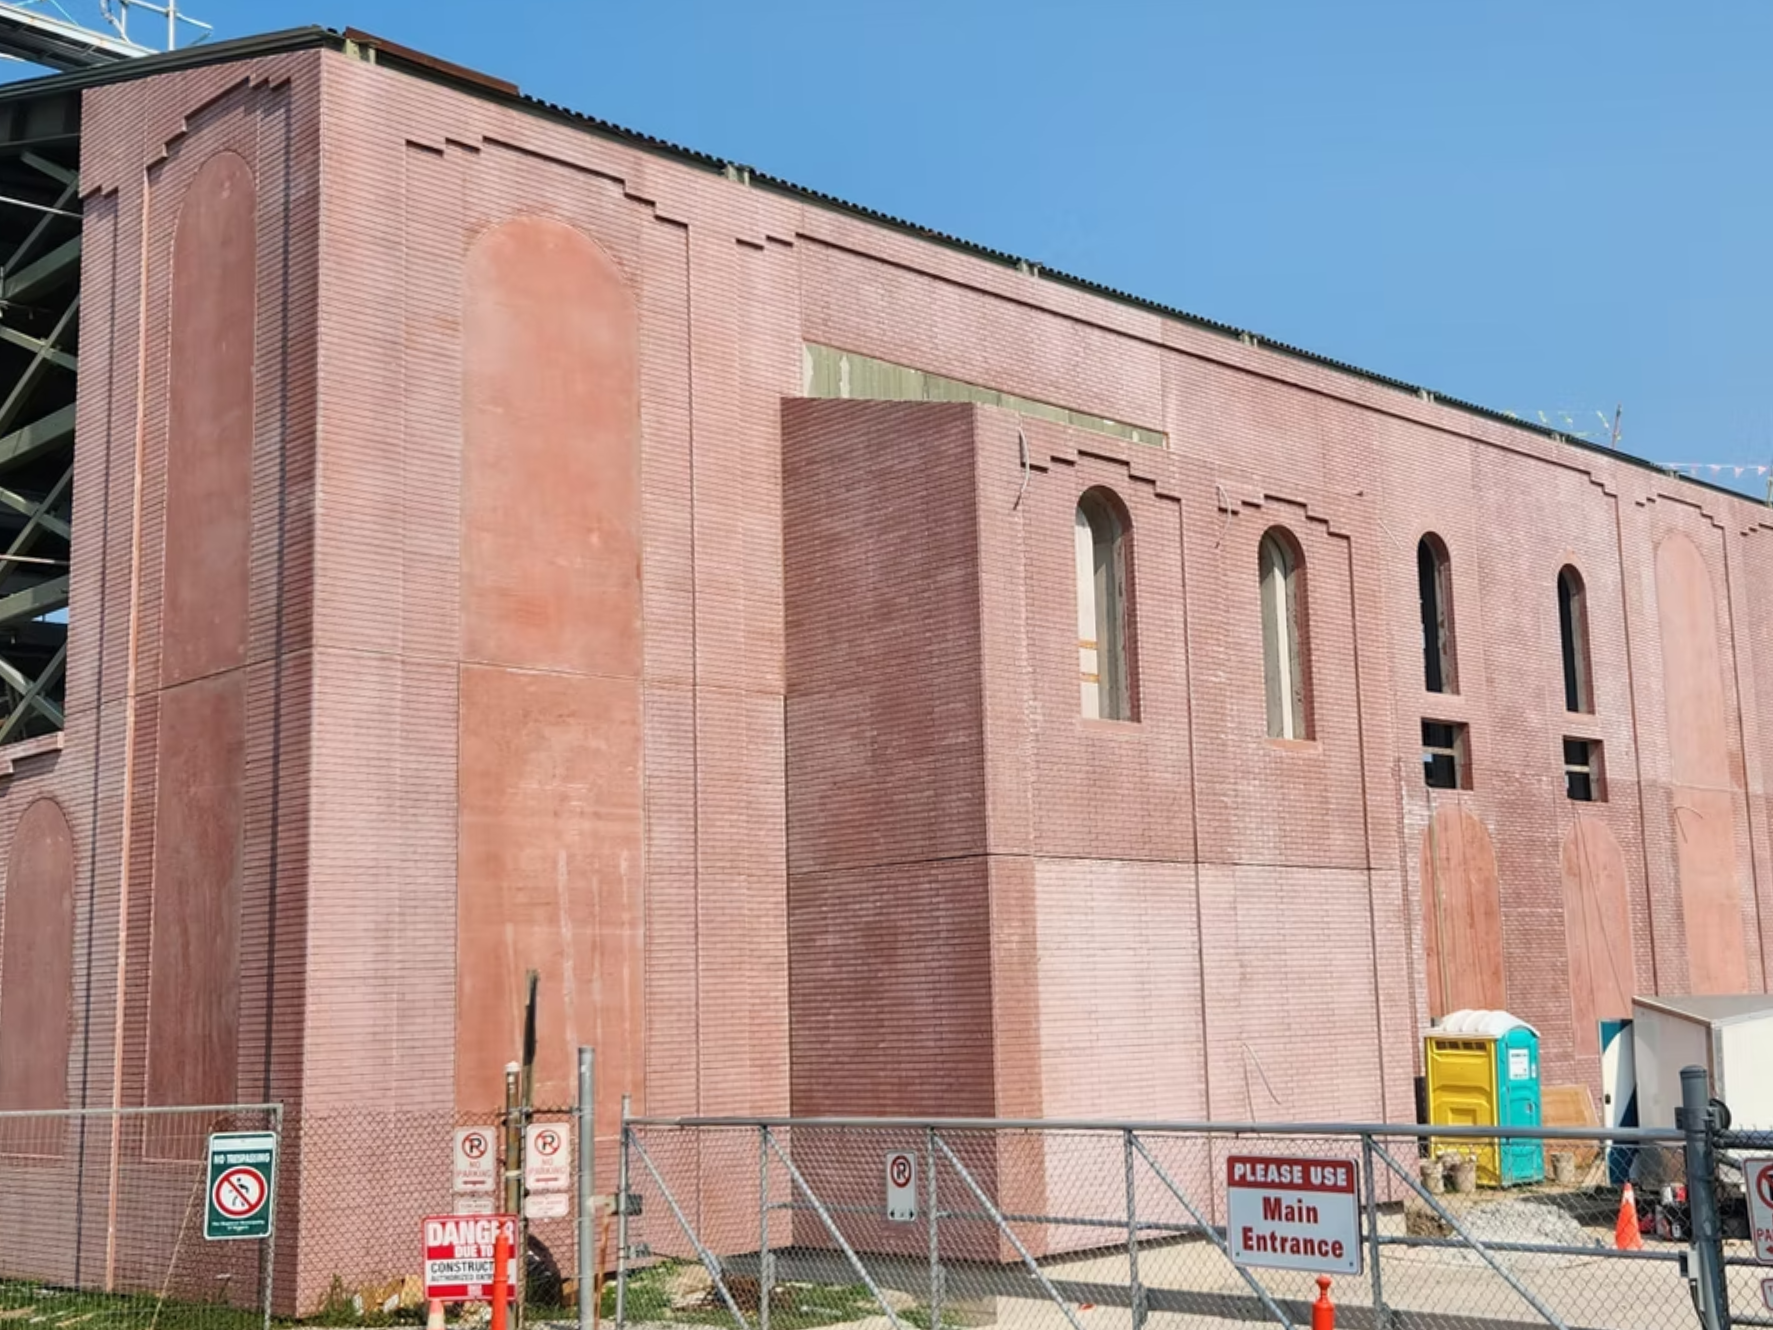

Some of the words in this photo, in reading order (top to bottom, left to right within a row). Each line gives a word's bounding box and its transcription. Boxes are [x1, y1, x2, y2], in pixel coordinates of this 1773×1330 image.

[213, 1154, 225, 1164] NO
[456, 1170, 492, 1178] PARKING
[1234, 1163, 1304, 1184] PLEASE
[1309, 1166, 1347, 1187] USE
[1262, 1196, 1319, 1224] Main
[1242, 1226, 1345, 1259] Entrance
[454, 1246, 478, 1258] DUE
[430, 1260, 494, 1273] CONSTRUCT
